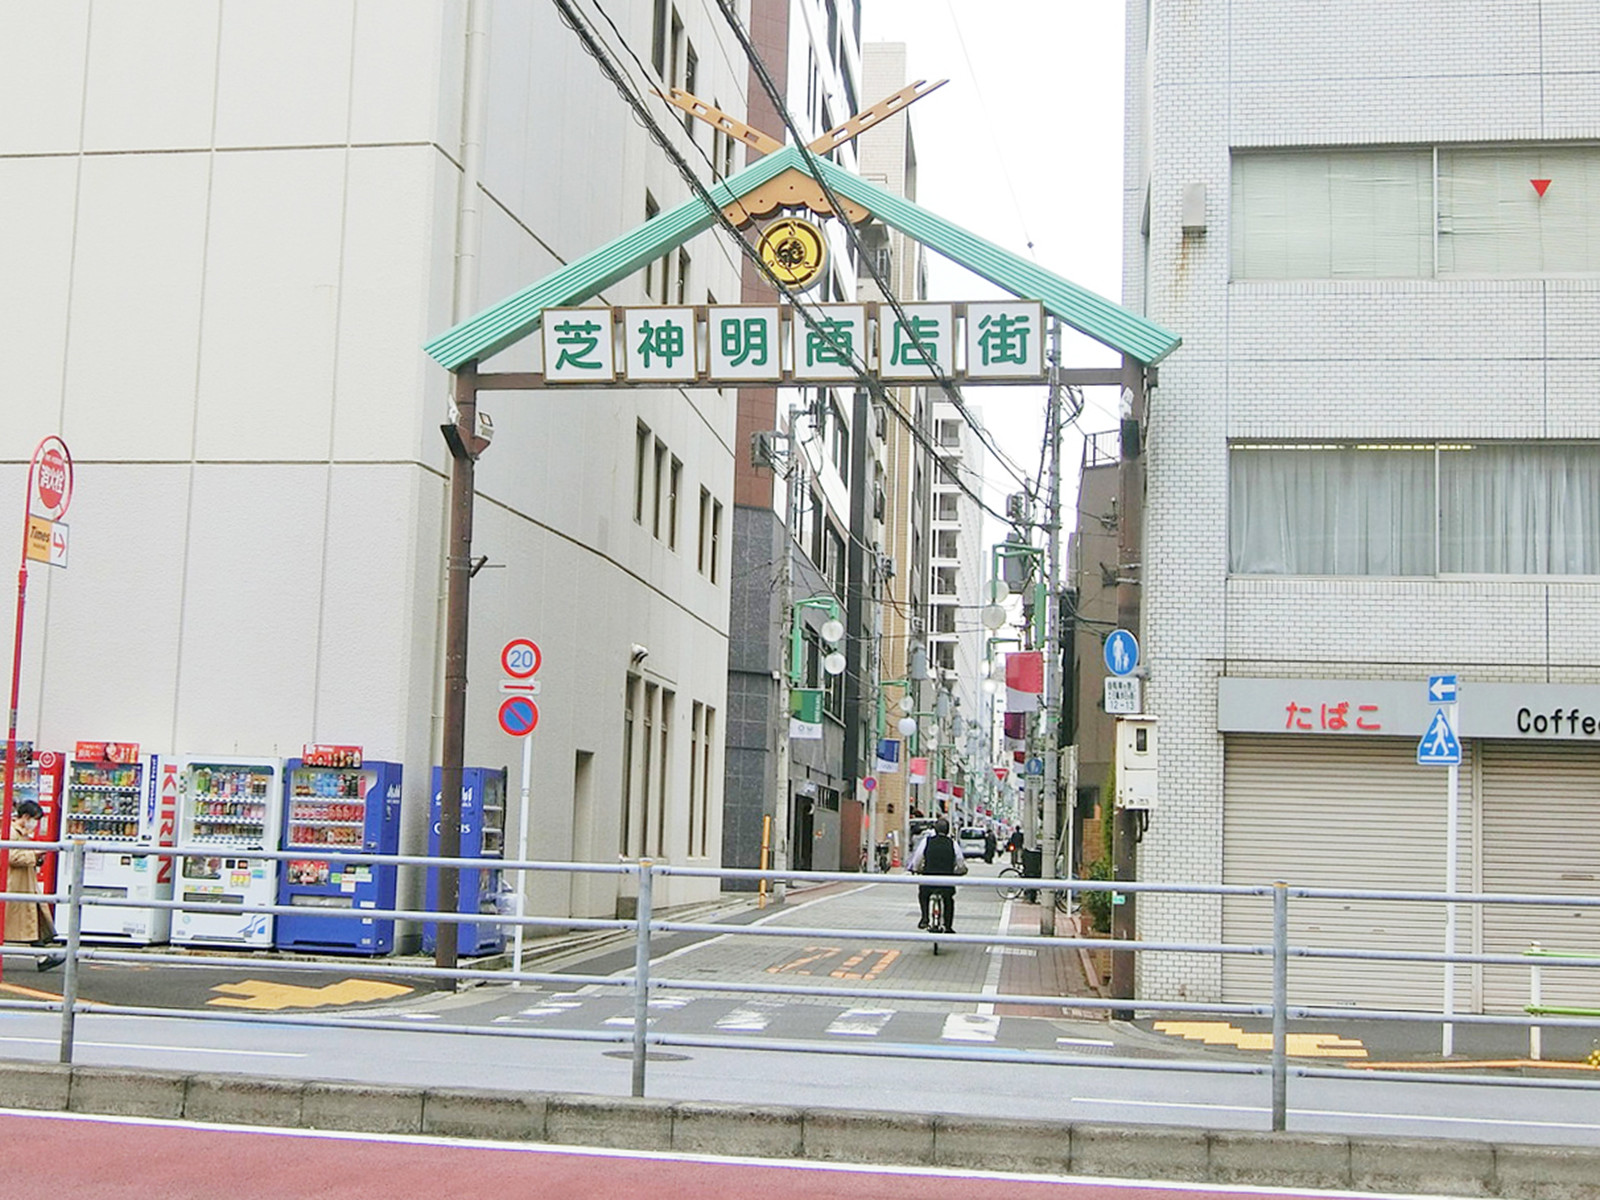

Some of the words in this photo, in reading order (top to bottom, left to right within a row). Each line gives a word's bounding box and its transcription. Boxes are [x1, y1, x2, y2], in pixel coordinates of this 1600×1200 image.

[554, 313, 1030, 371] 芝神明商店街
[40, 464, 64, 494] 消火栓
[30, 525, 51, 543] Times
[510, 650, 533, 668] 20
[1286, 701, 1381, 731] たばこ
[1517, 707, 1600, 735] Coffe
[156, 763, 178, 884] KIRIN
[767, 946, 902, 980] 20
